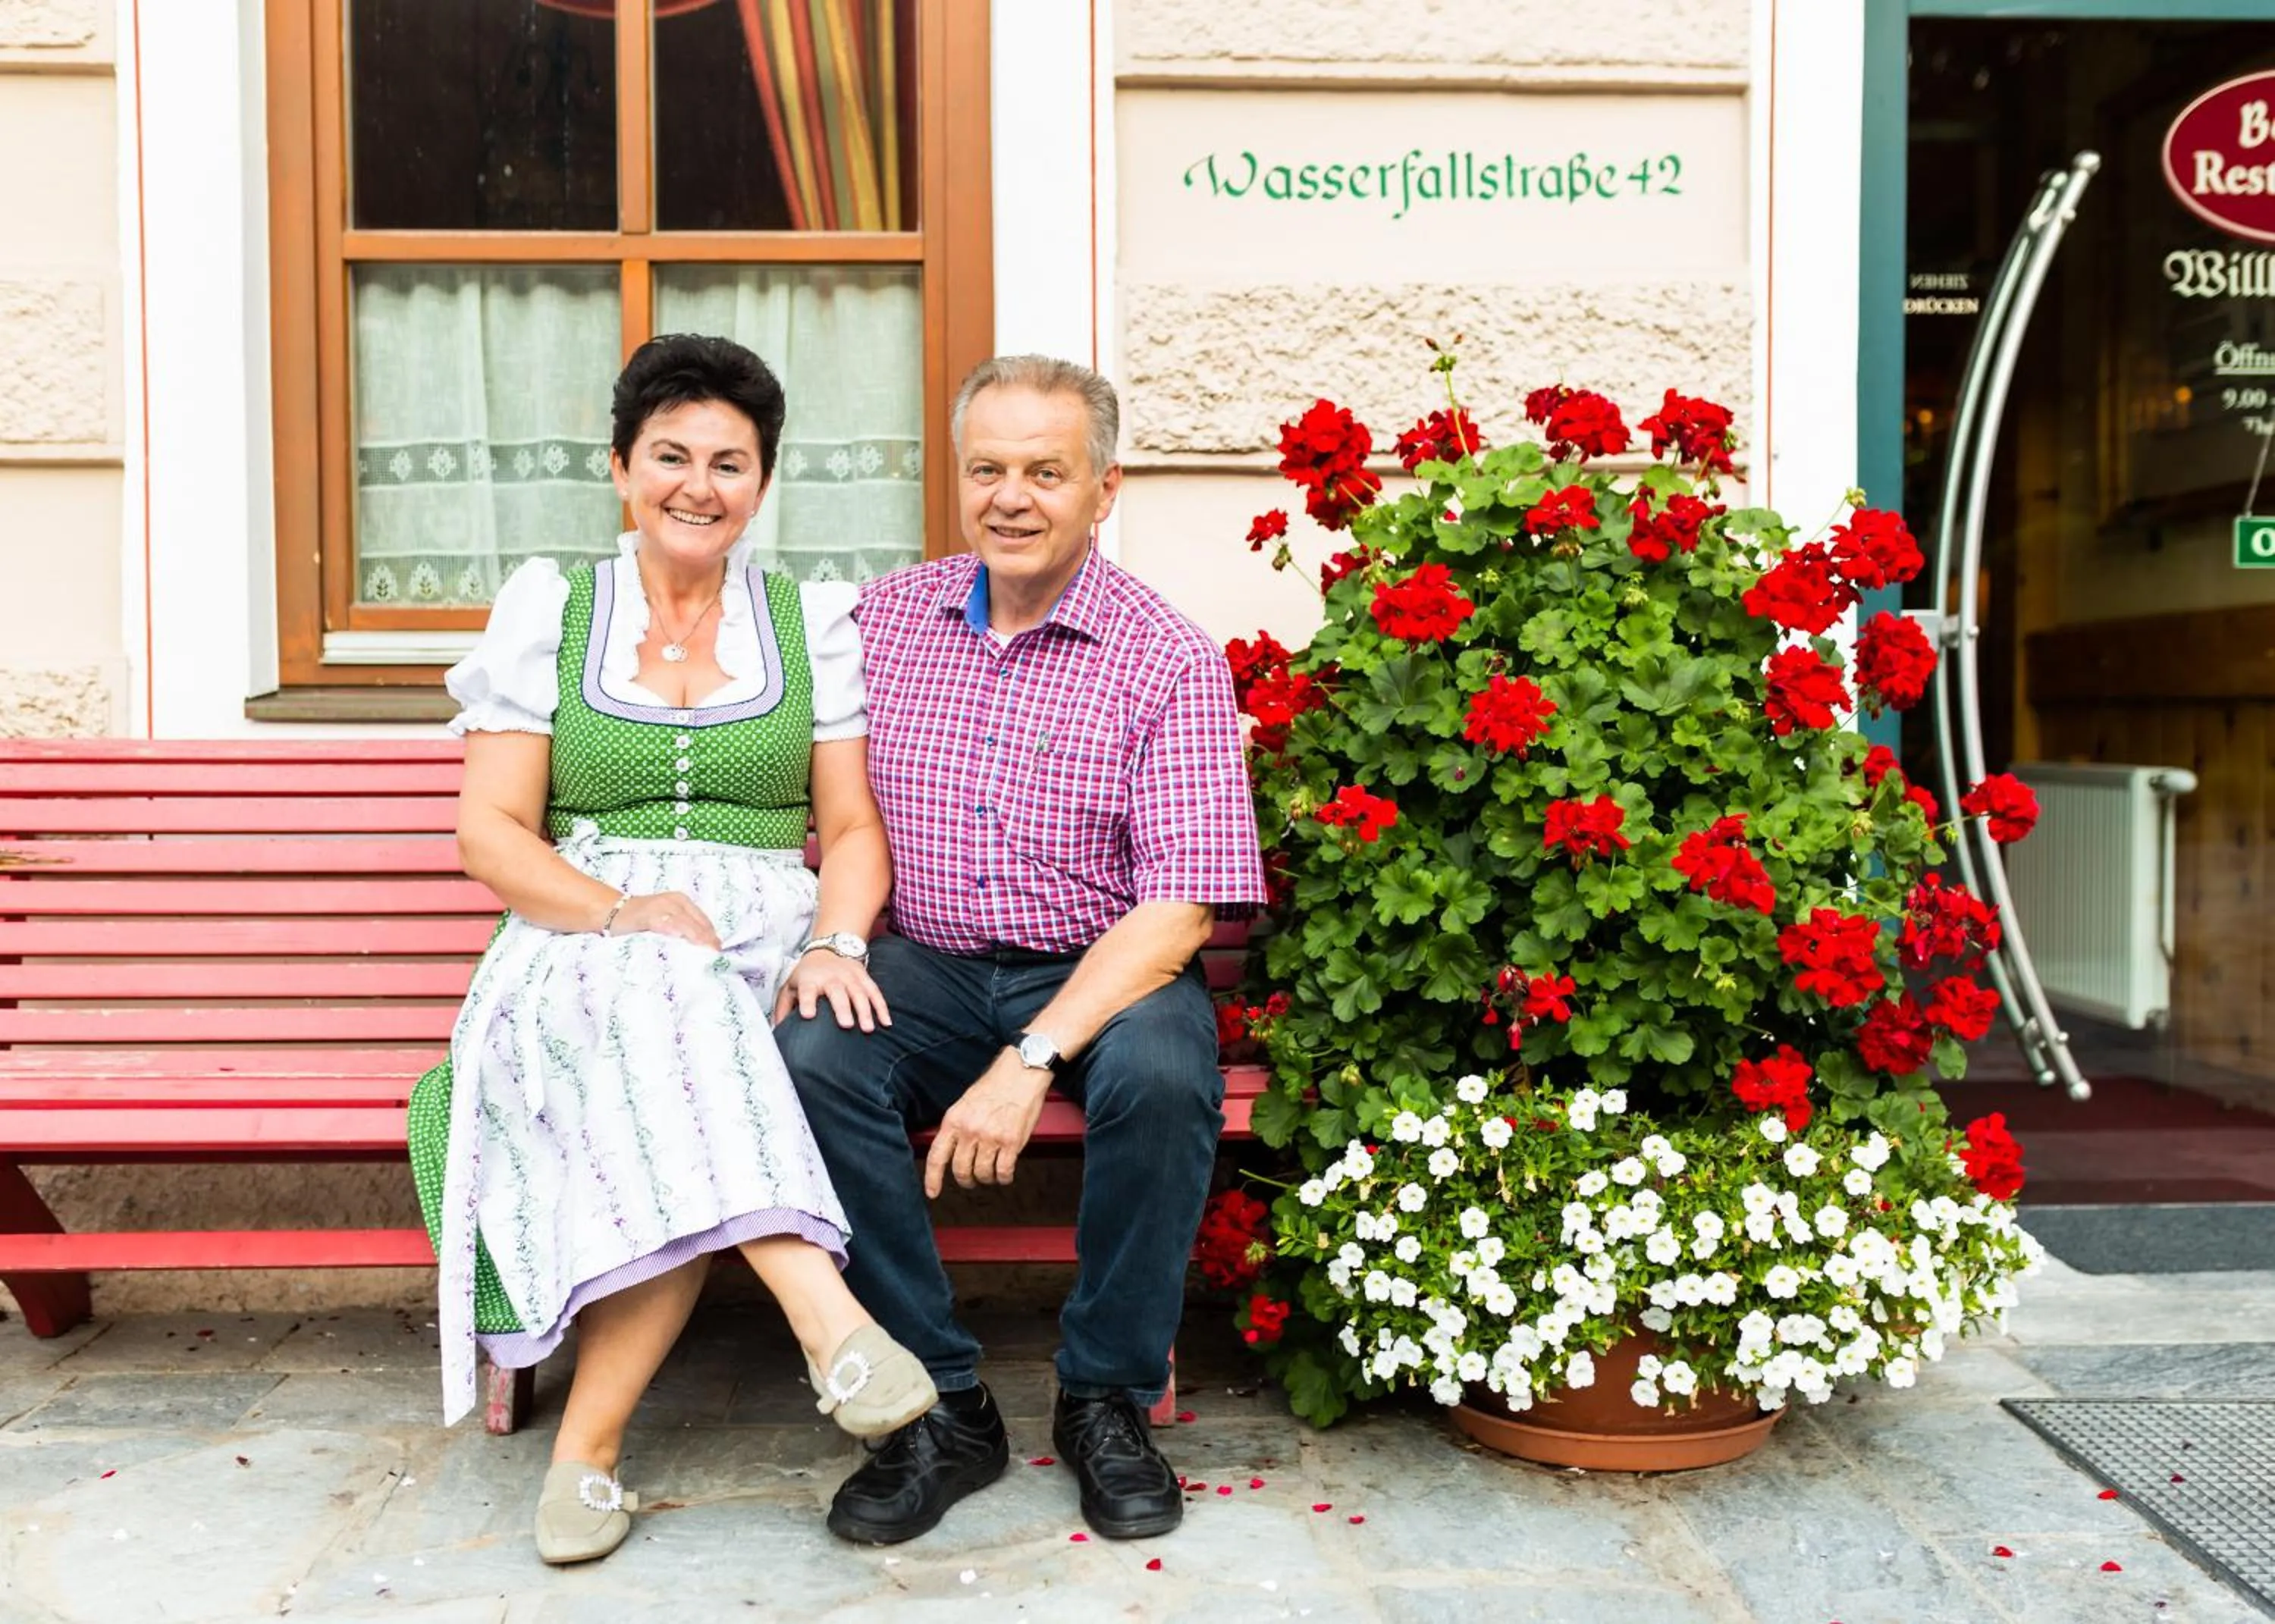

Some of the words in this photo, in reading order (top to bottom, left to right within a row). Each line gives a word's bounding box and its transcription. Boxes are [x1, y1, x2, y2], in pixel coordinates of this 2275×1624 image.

[2239, 99, 2275, 149] B
[1183, 149, 1618, 219] Wasserfallstraße
[1626, 153, 1682, 195] 42
[1902, 296, 1979, 315] DRÜCKEN
